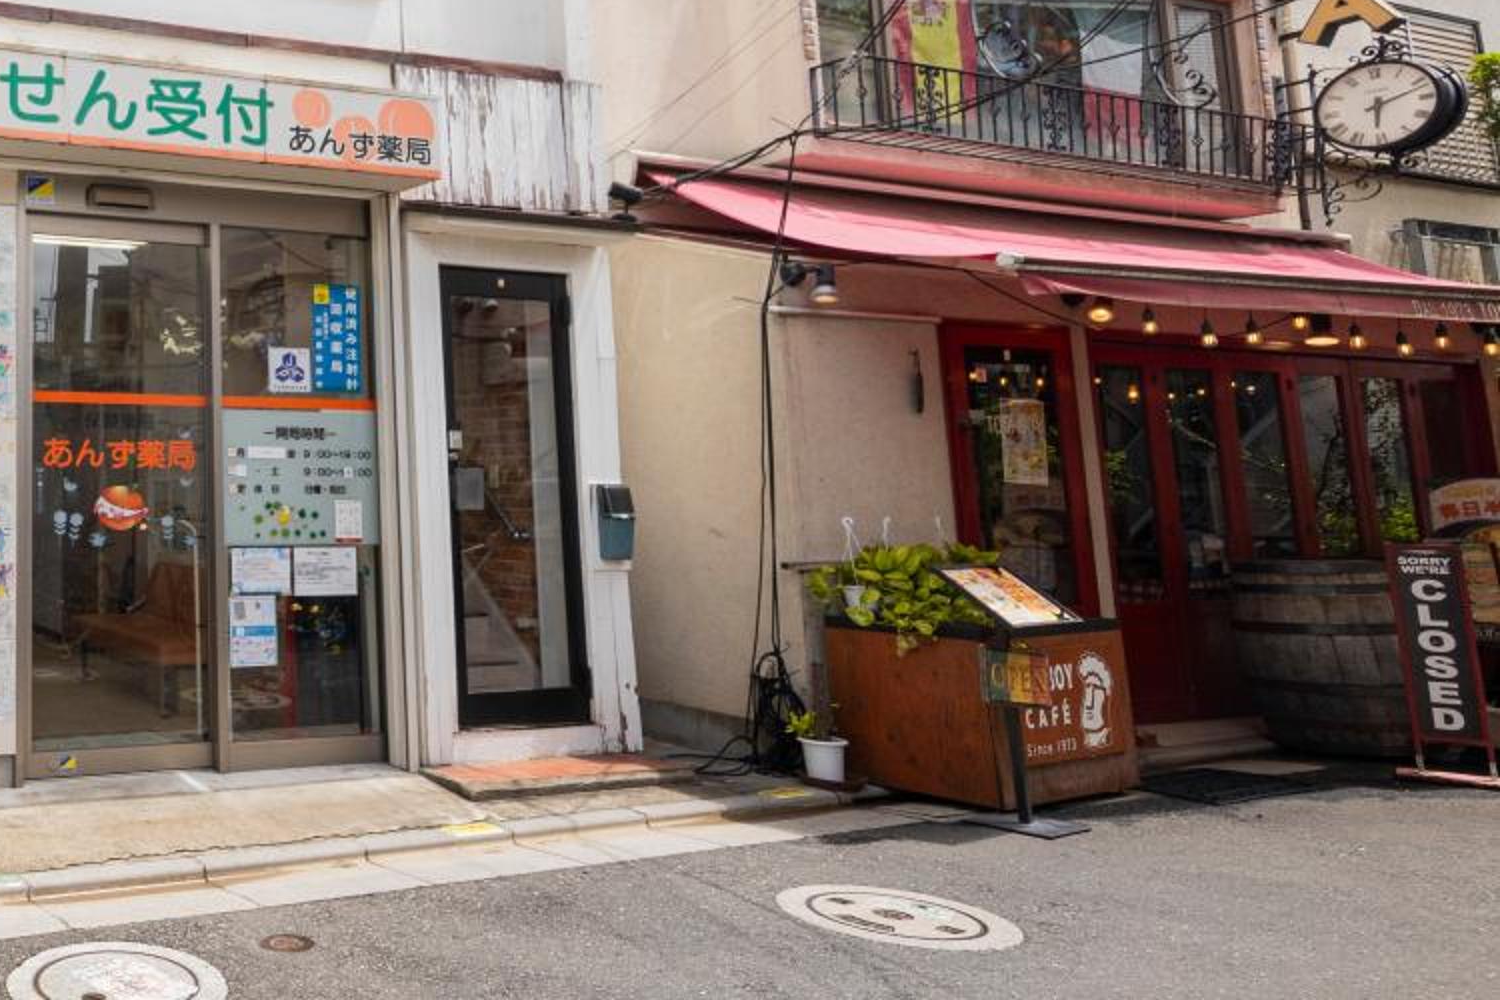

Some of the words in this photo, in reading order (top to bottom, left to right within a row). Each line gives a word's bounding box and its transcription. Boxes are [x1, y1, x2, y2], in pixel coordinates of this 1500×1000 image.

[288, 124, 432, 166] あんず薬局
[42, 437, 197, 473] あんず薬局
[1397, 555, 1452, 566] SORRY
[1400, 564, 1452, 576] WE'RE
[1410, 578, 1466, 732] CLOSED
[1025, 696, 1072, 730] CAFÉ
